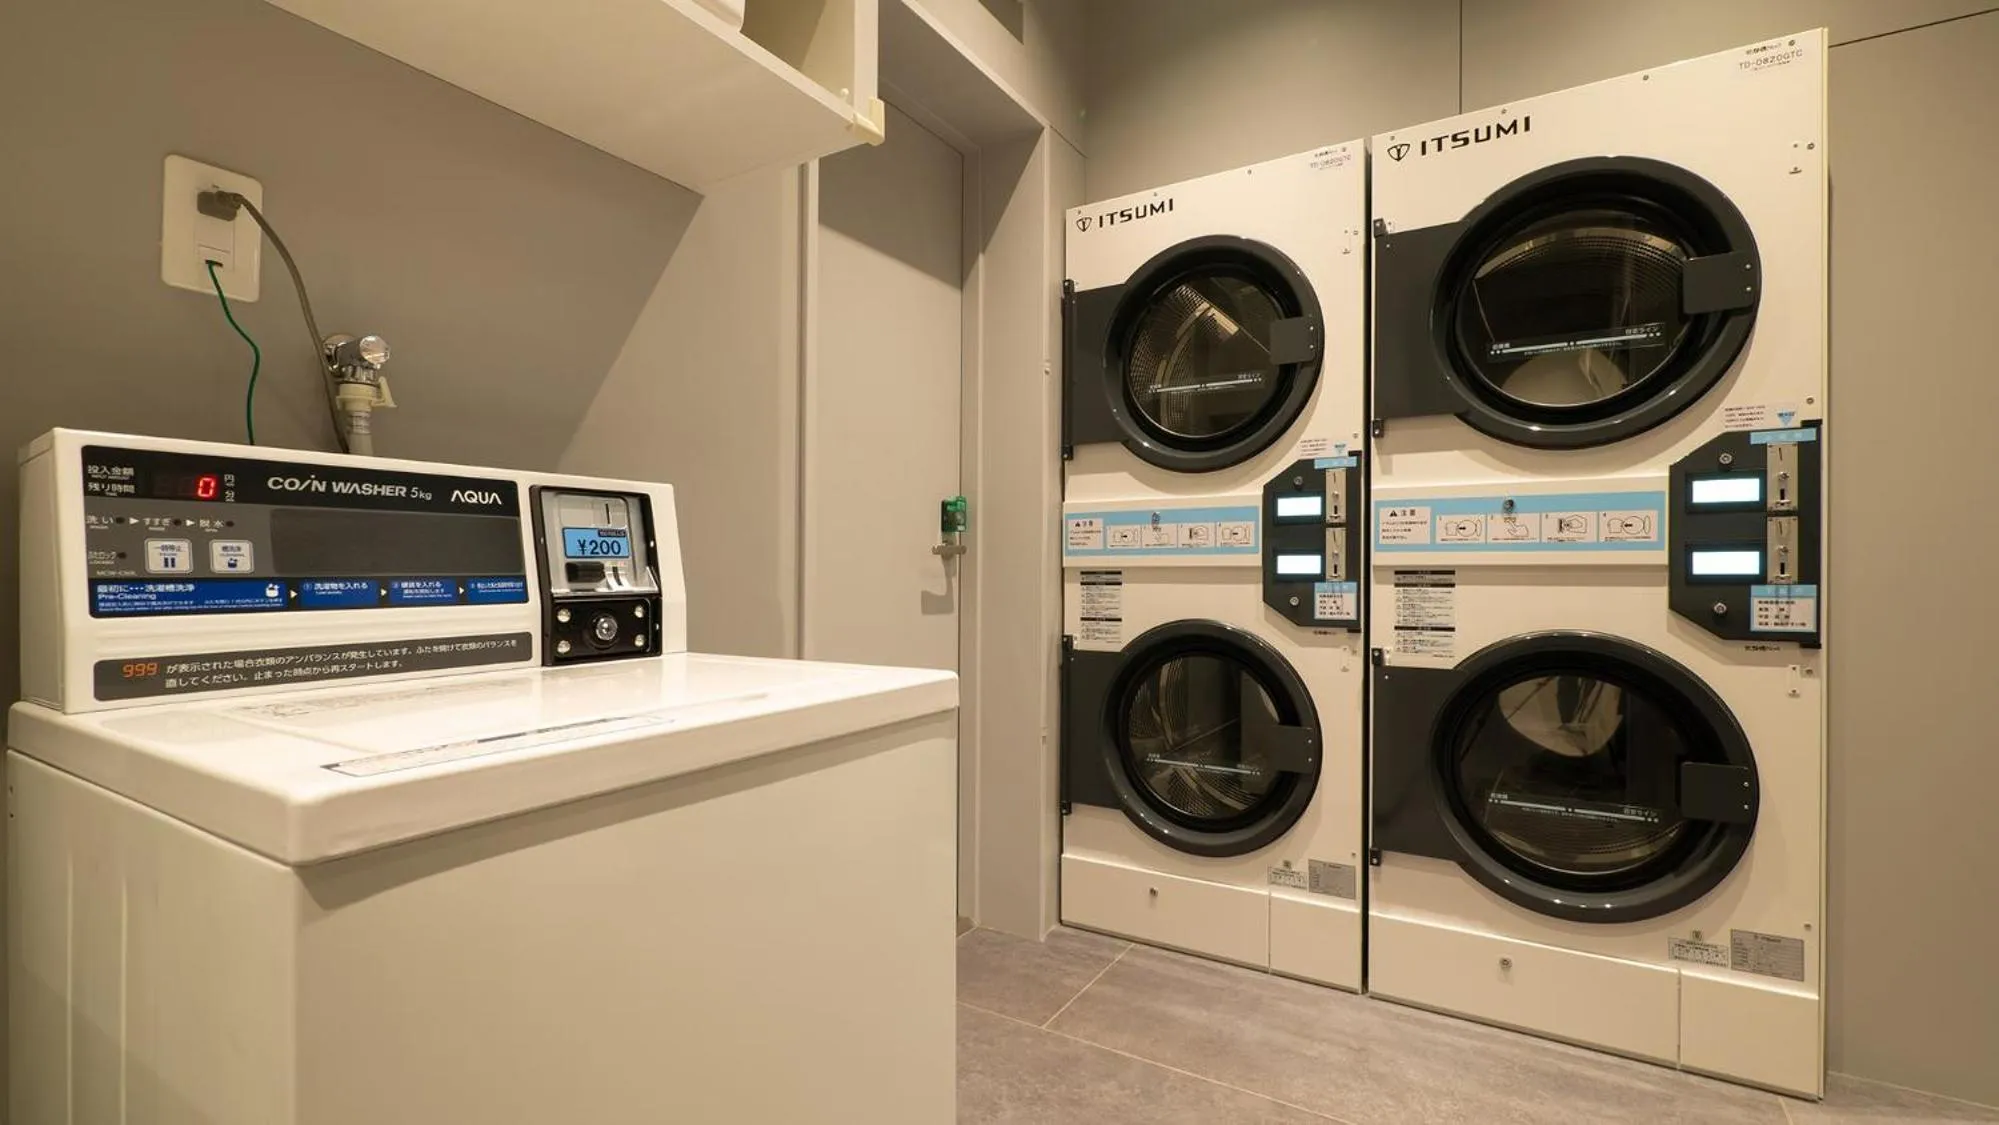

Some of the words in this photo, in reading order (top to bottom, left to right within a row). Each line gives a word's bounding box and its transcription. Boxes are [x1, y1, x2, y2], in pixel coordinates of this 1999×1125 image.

[1421, 116, 1531, 156] ITSUMI
[1099, 198, 1174, 228] ITSUMI
[87, 465, 134, 476] 投入金額
[88, 482, 136, 494] 残り時間
[198, 477, 215, 497] 0
[332, 481, 406, 498] WASHER
[410, 487, 432, 501] 5kg
[451, 490, 502, 505] AQUA
[577, 539, 621, 555] ¥200
[123, 663, 158, 678] 999
